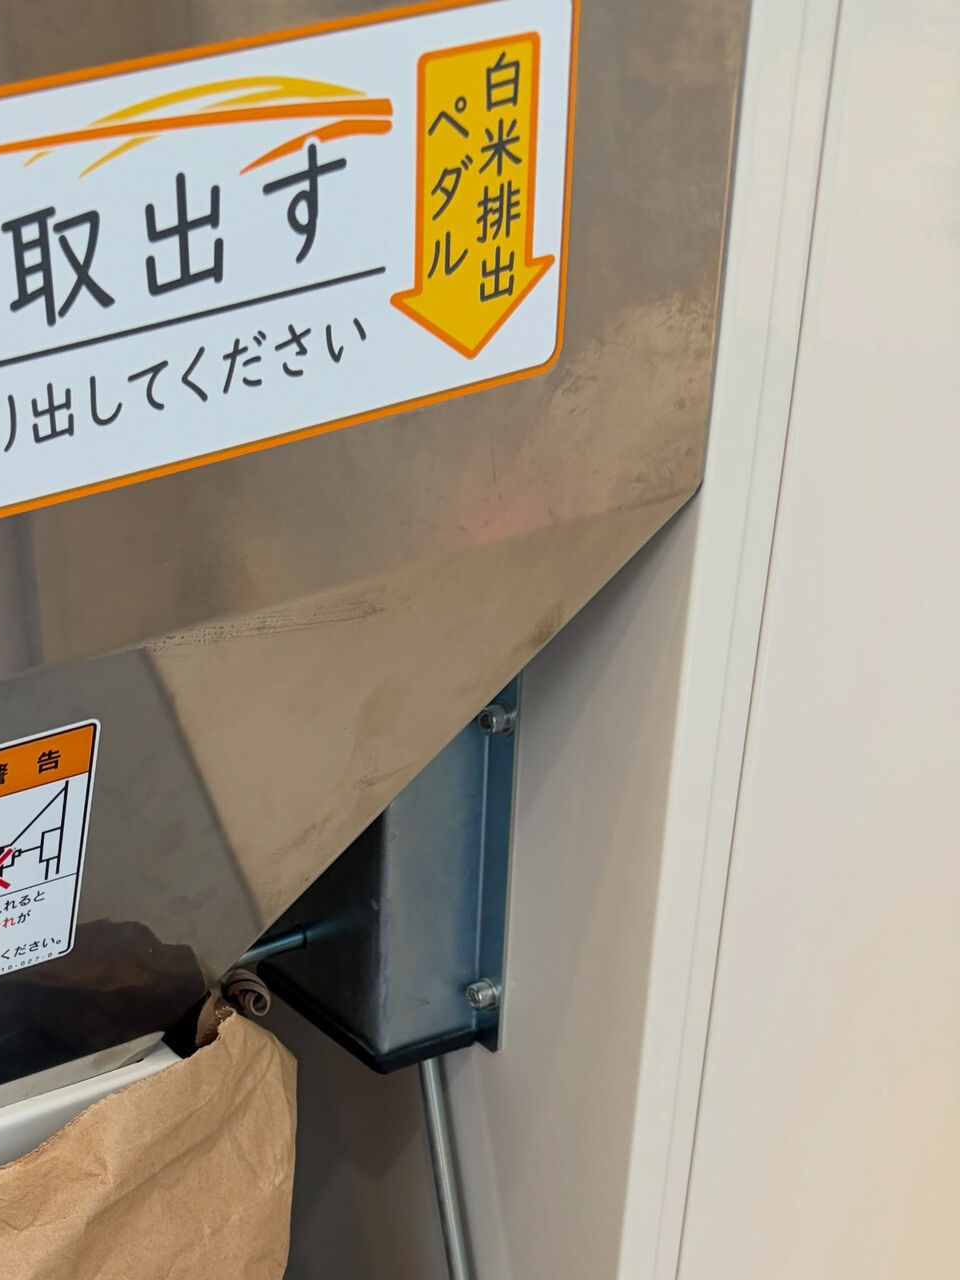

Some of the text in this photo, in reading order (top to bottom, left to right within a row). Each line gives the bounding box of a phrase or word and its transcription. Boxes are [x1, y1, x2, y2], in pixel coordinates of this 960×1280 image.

[427, 96, 473, 279] ペダル
[477, 52, 522, 302] 白米排出
